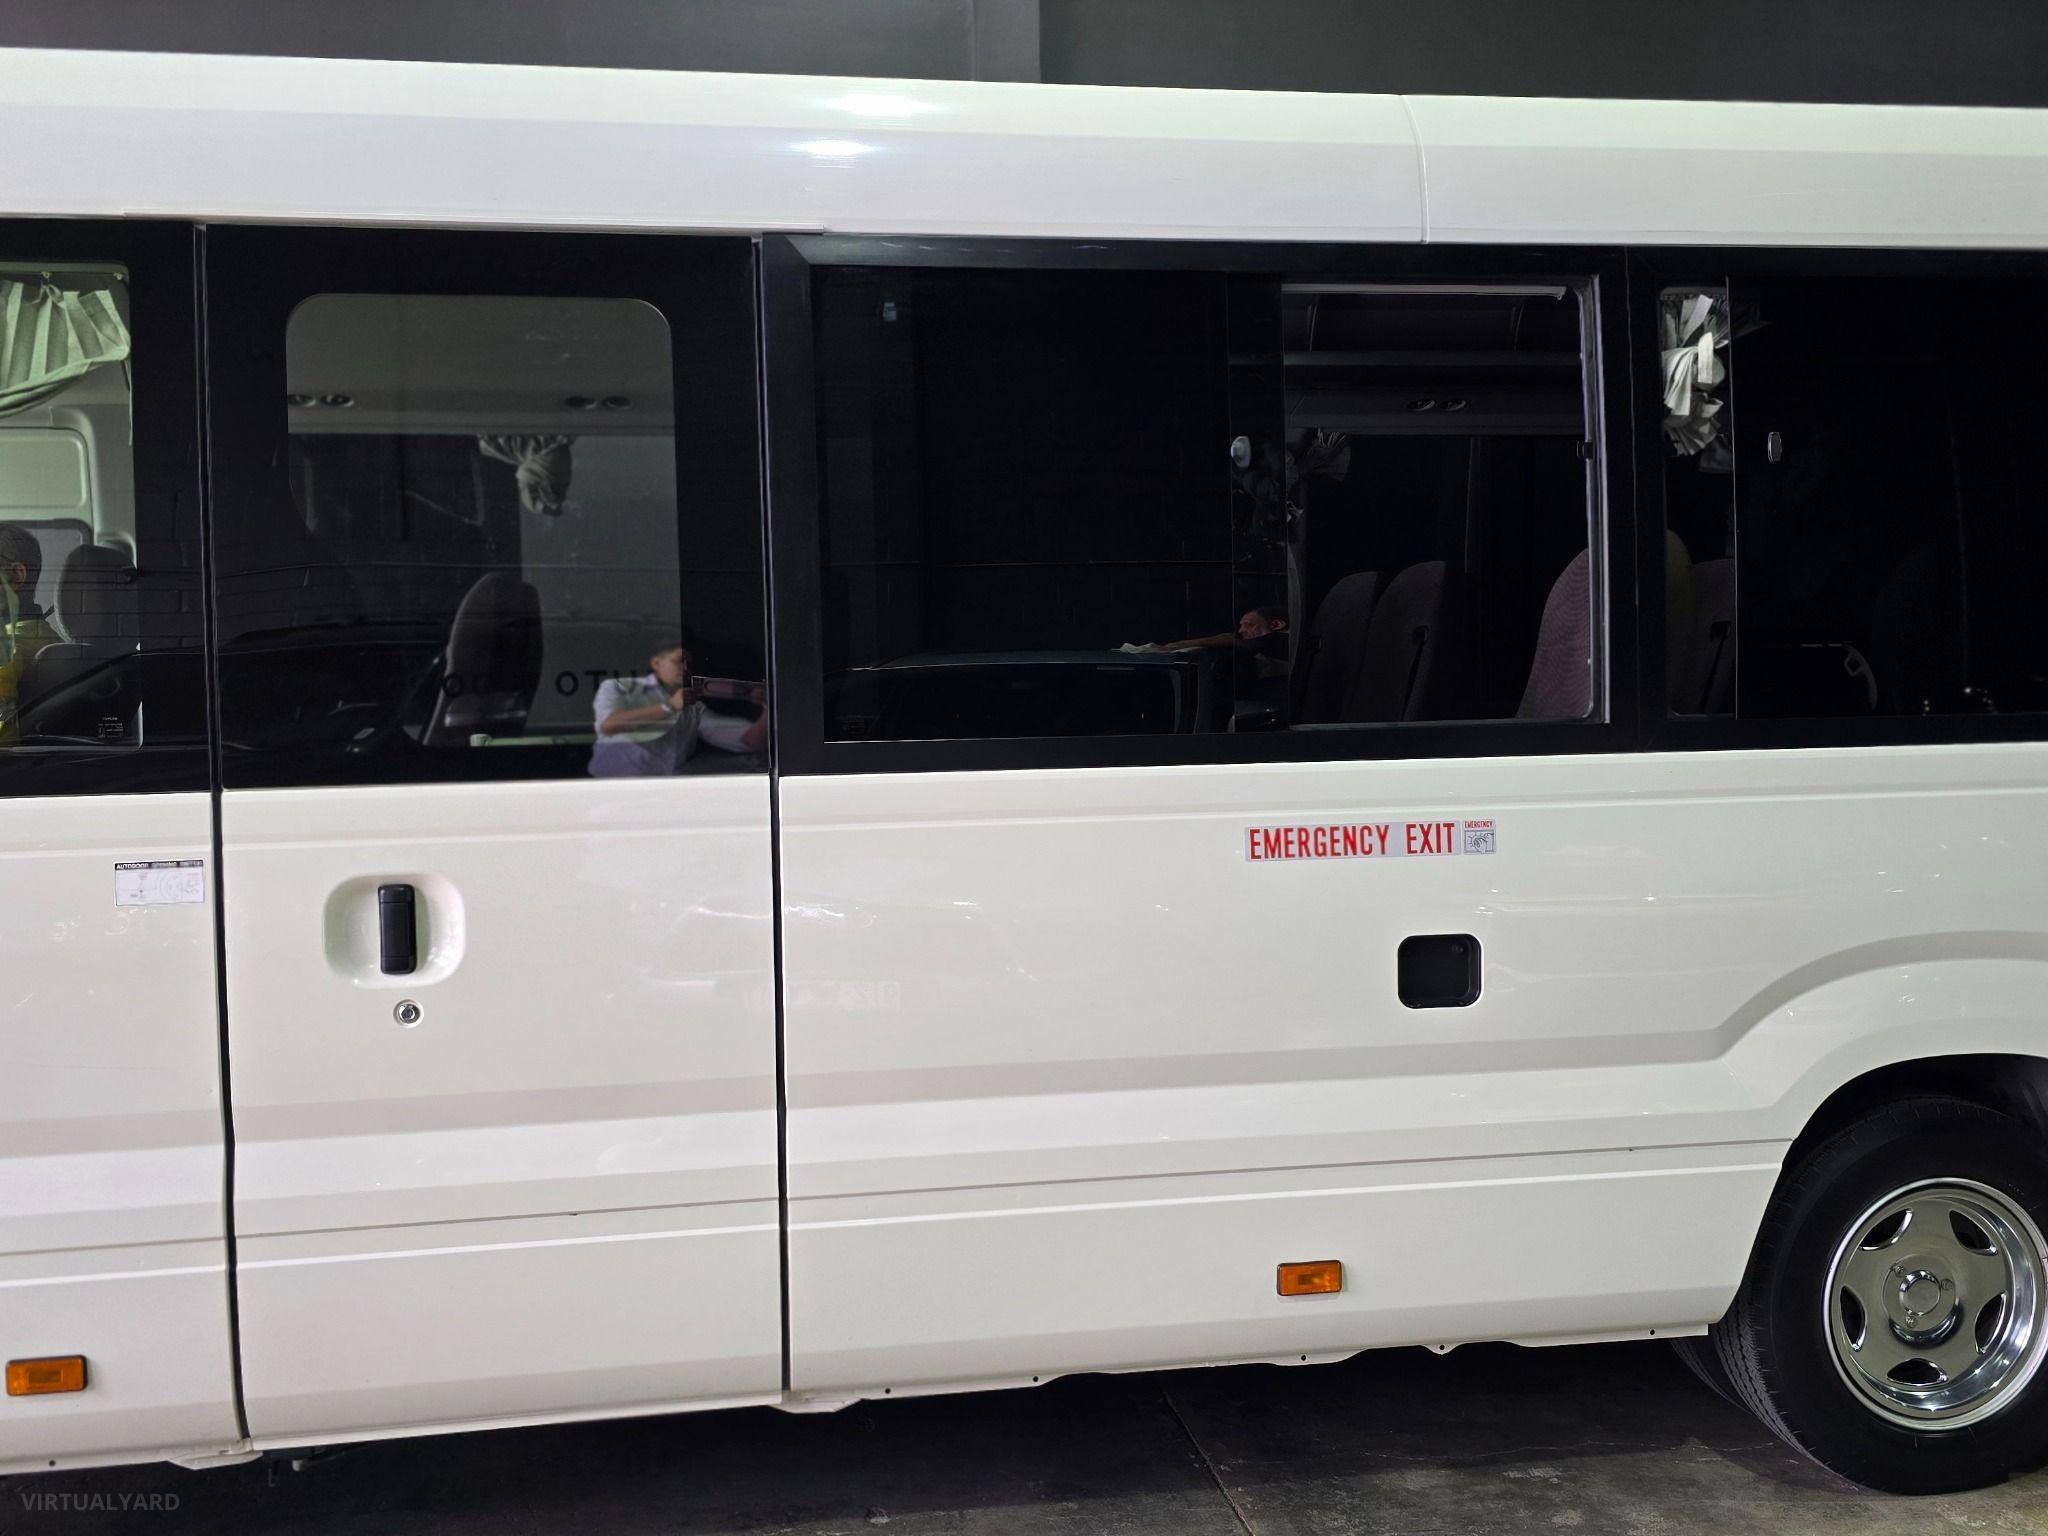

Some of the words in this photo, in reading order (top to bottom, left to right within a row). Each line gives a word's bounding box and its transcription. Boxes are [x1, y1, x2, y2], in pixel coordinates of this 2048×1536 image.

[1464, 820, 1493, 829] EMERGENCY
[1249, 824, 1390, 860] EMERGENCY
[1405, 822, 1456, 856] EXIT
